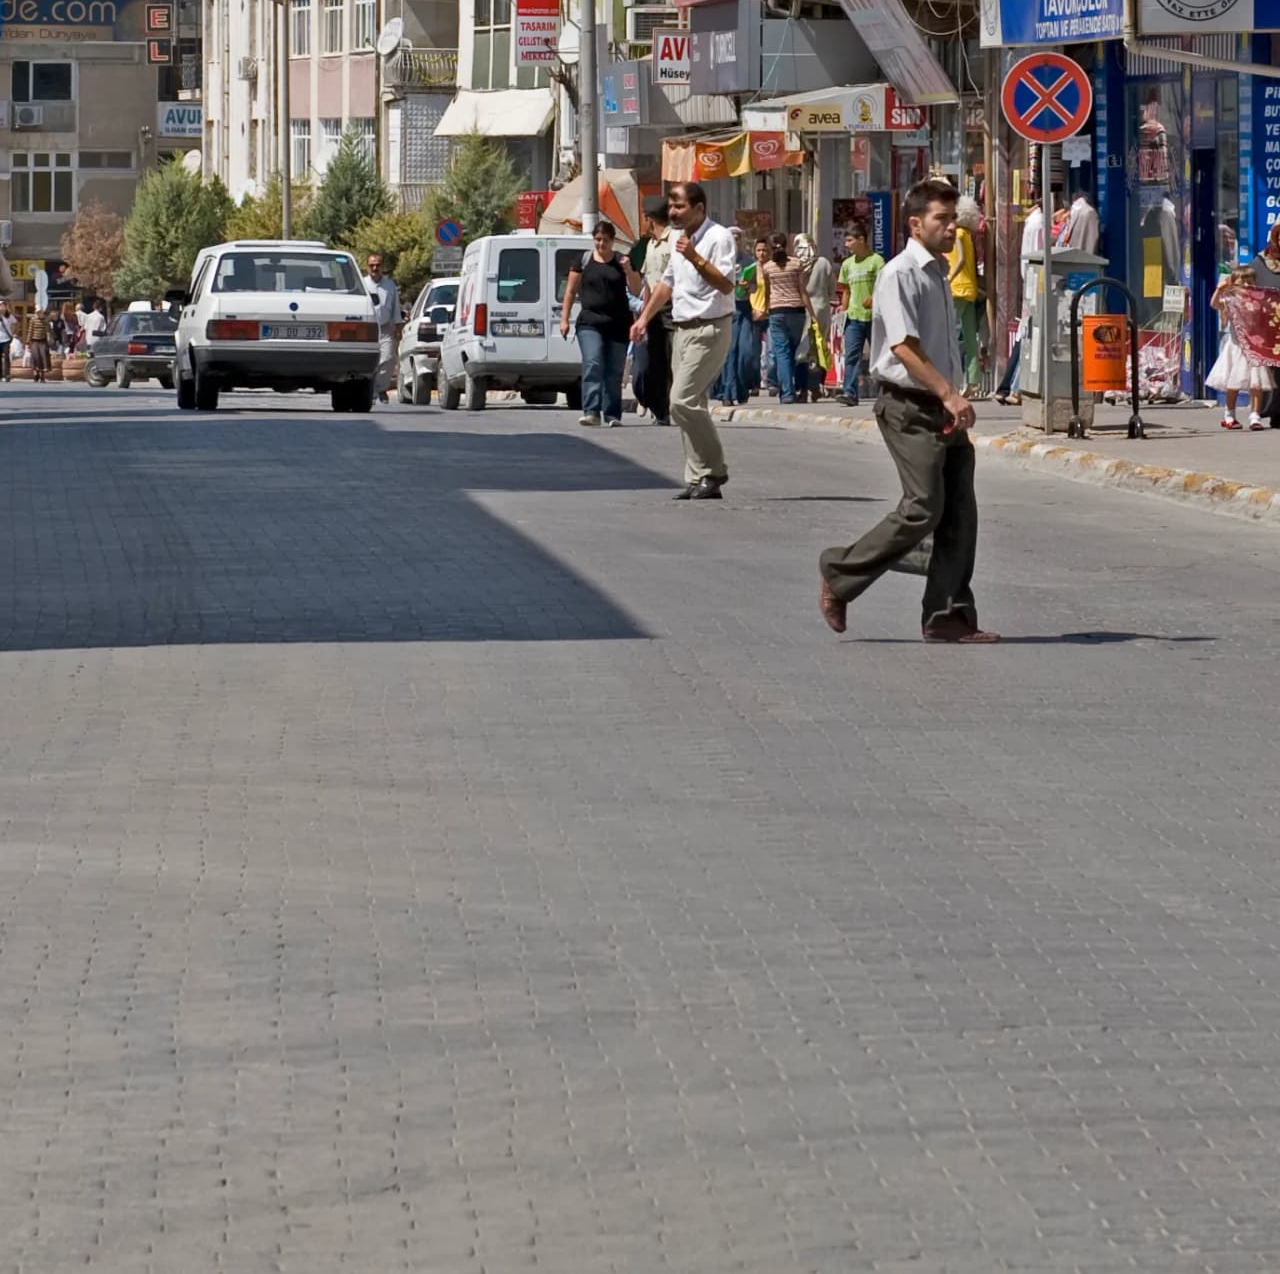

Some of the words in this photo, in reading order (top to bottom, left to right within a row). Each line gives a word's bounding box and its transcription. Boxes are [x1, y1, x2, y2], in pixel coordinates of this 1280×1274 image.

[1189, 7, 1217, 18] ETTE
[660, 37, 690, 61] AV
[809, 112, 841, 125] avea
